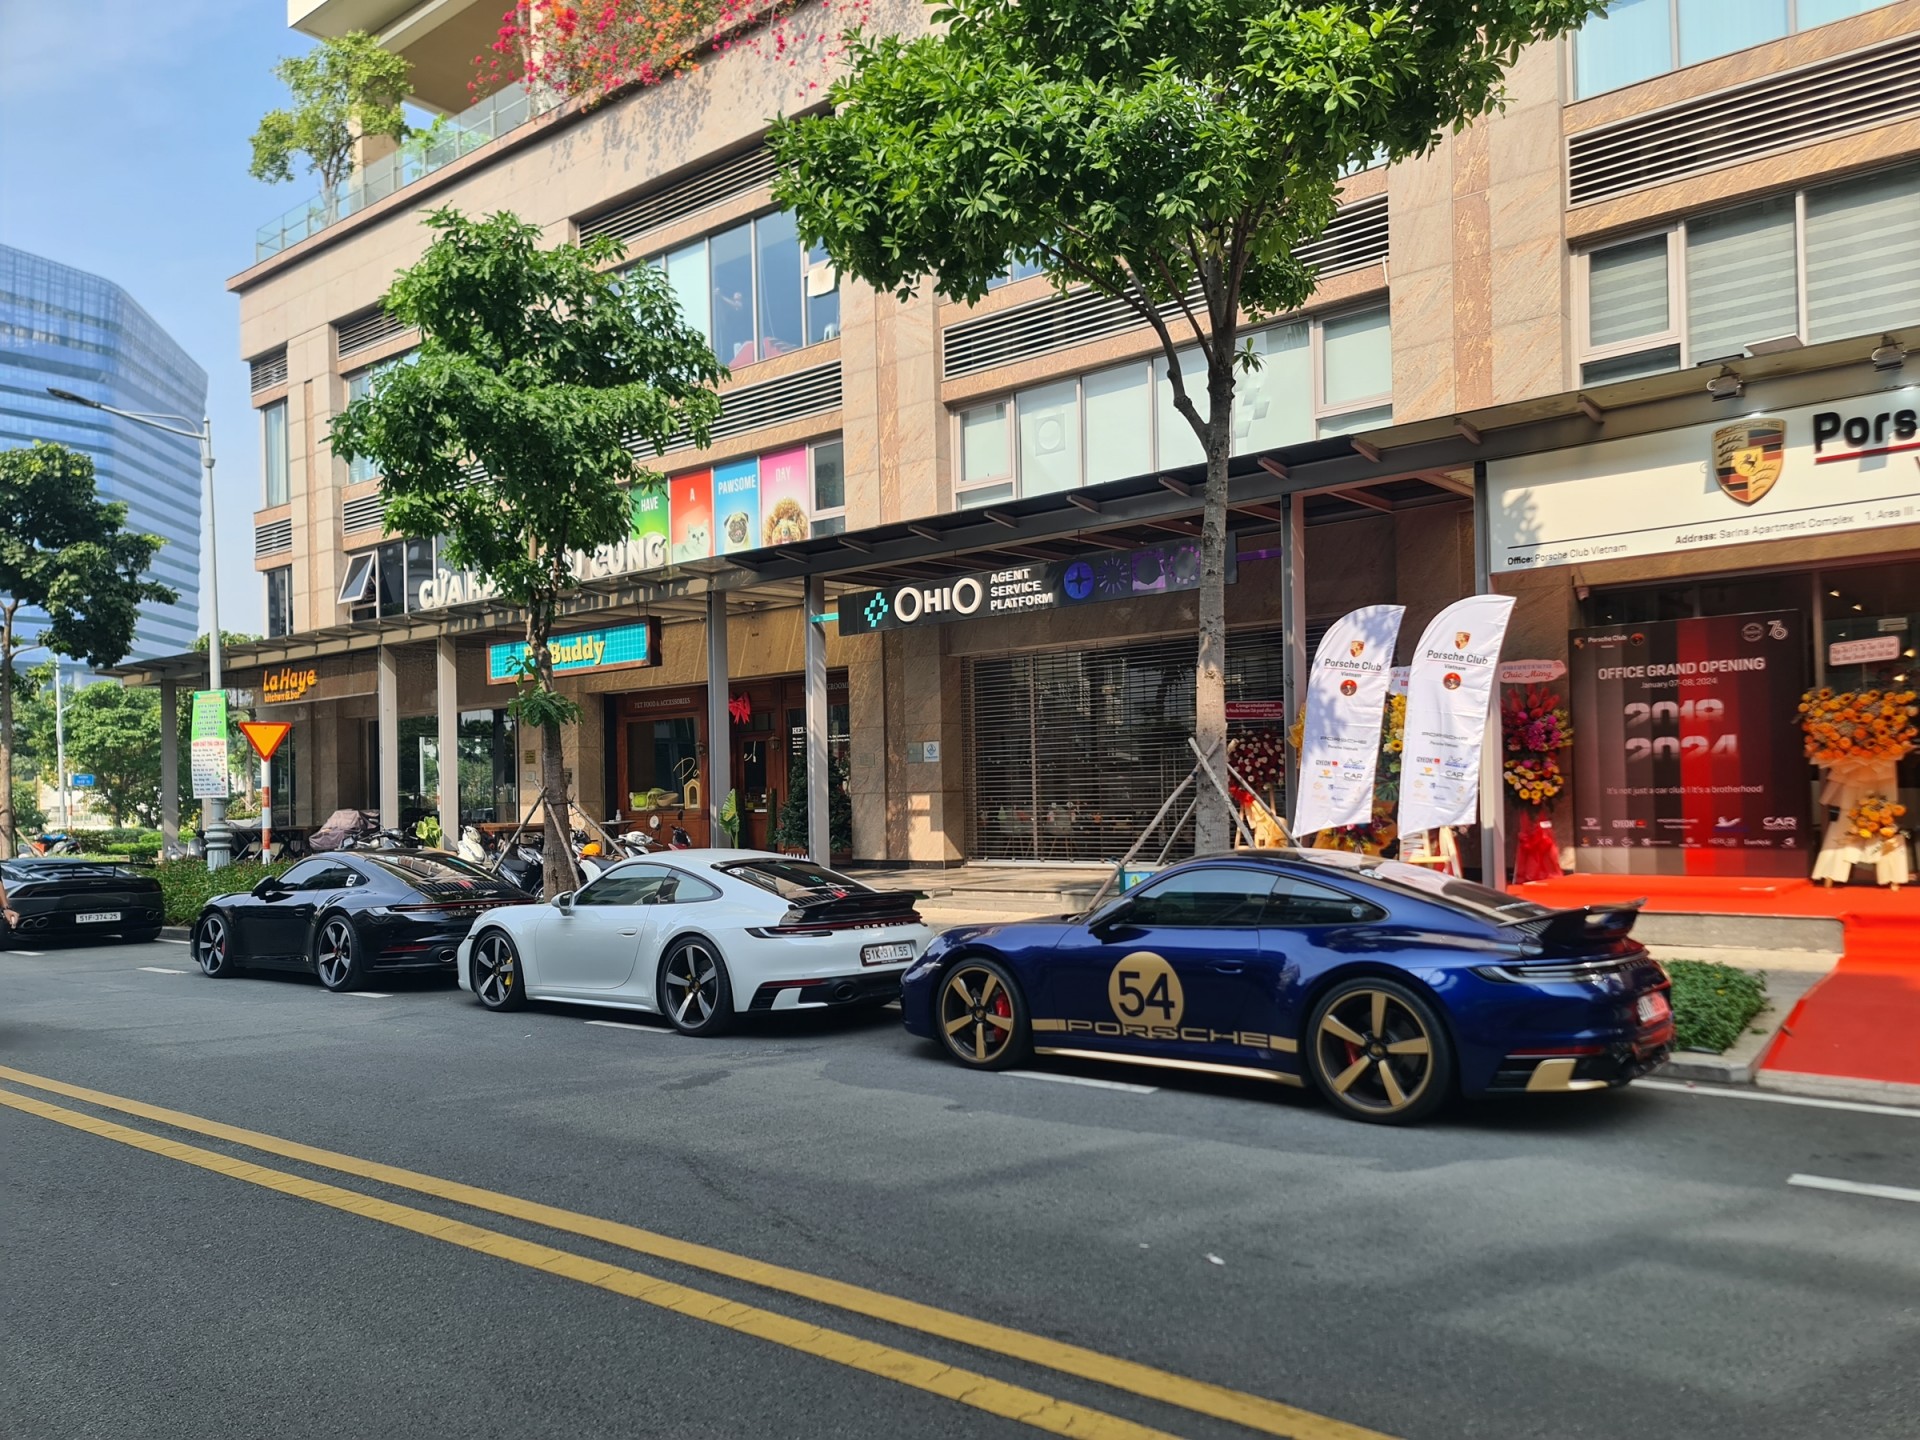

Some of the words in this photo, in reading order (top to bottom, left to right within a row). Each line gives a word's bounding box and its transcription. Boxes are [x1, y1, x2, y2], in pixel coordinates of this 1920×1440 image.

[1813, 409, 1918, 454] Pors
[640, 496, 659, 513] HAVE
[690, 488, 696, 502] A
[718, 474, 756, 496] PAWSOME
[775, 466, 792, 482] DAY
[1675, 532, 1717, 545] Address:
[1719, 528, 1750, 539] Sarina
[1752, 520, 1806, 536] Apartment
[1808, 514, 1855, 529] Complex
[1507, 556, 1534, 566] Office:
[1535, 552, 1568, 562] Porsche
[1570, 548, 1589, 558] Club
[1591, 544, 1628, 555] Vietnam
[990, 568, 1031, 584] AGENT
[419, 567, 464, 609] CỬA
[990, 581, 1042, 597] SERVICE
[894, 577, 982, 622] OHIO
[990, 592, 1054, 611] PLATFORM
[550, 635, 605, 665] Buddy
[1426, 649, 1465, 662] Porsche
[1466, 654, 1488, 665] Club
[1324, 658, 1360, 669] Porsche
[1361, 661, 1382, 672] Club
[1598, 665, 1645, 680] OFFICE
[1647, 662, 1697, 677] GRAND
[1699, 657, 1766, 674] OPENING
[1641, 680, 1668, 689] January
[1696, 677, 1718, 685] 2024
[644, 699, 656, 708] FOOD
[661, 697, 691, 706] ACCESSORIES
[1632, 787, 1647, 796] just
[1668, 786, 1685, 794] club
[1763, 817, 1797, 826] CAR
[1118, 971, 1175, 1021] 54
[1068, 1019, 1269, 1049] PORSCHE
